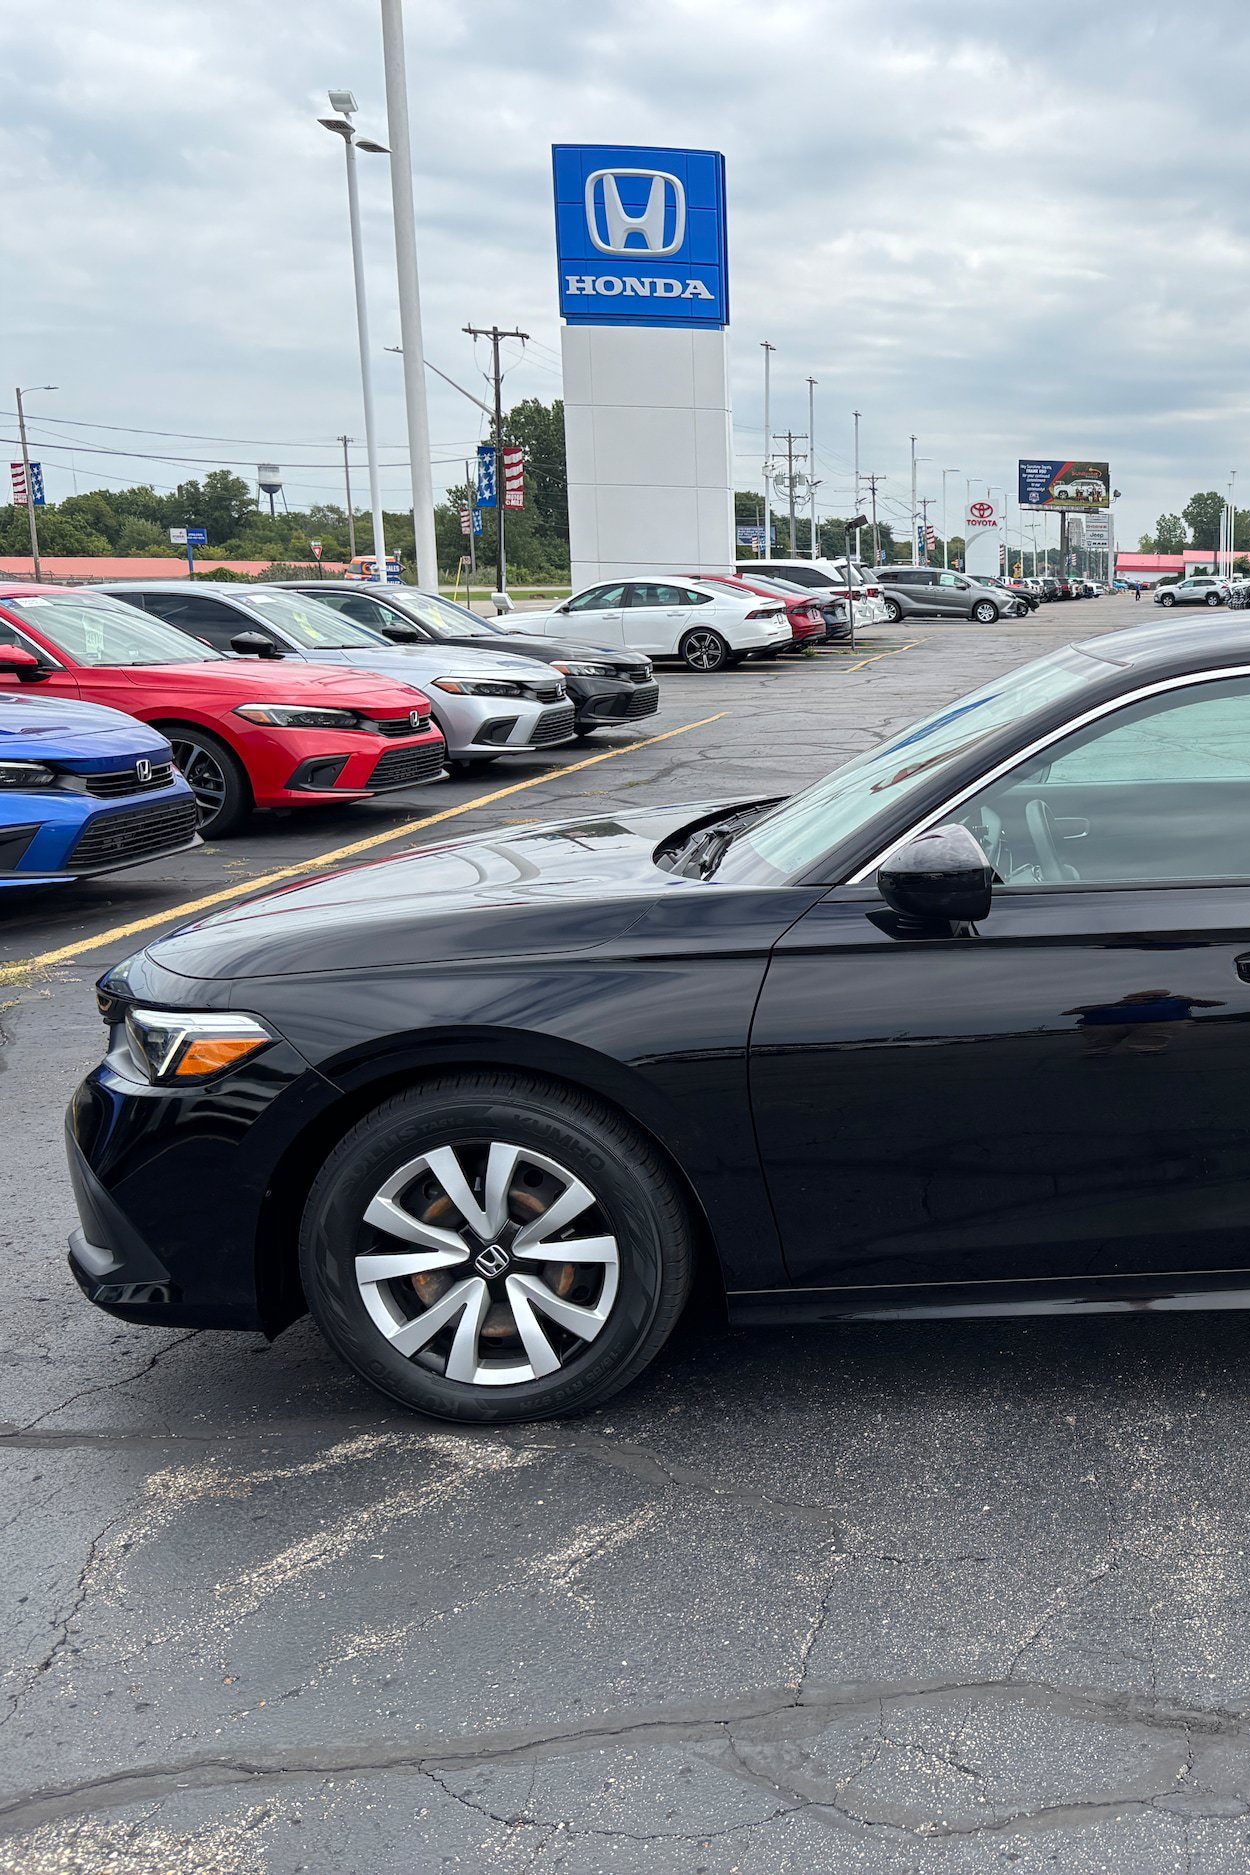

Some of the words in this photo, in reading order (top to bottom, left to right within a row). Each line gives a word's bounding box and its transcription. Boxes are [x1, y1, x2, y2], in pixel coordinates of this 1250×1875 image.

[565, 275, 715, 300] HONDA
[966, 519, 997, 527] TOYOTA
[512, 1114, 605, 1172] KUMHO
